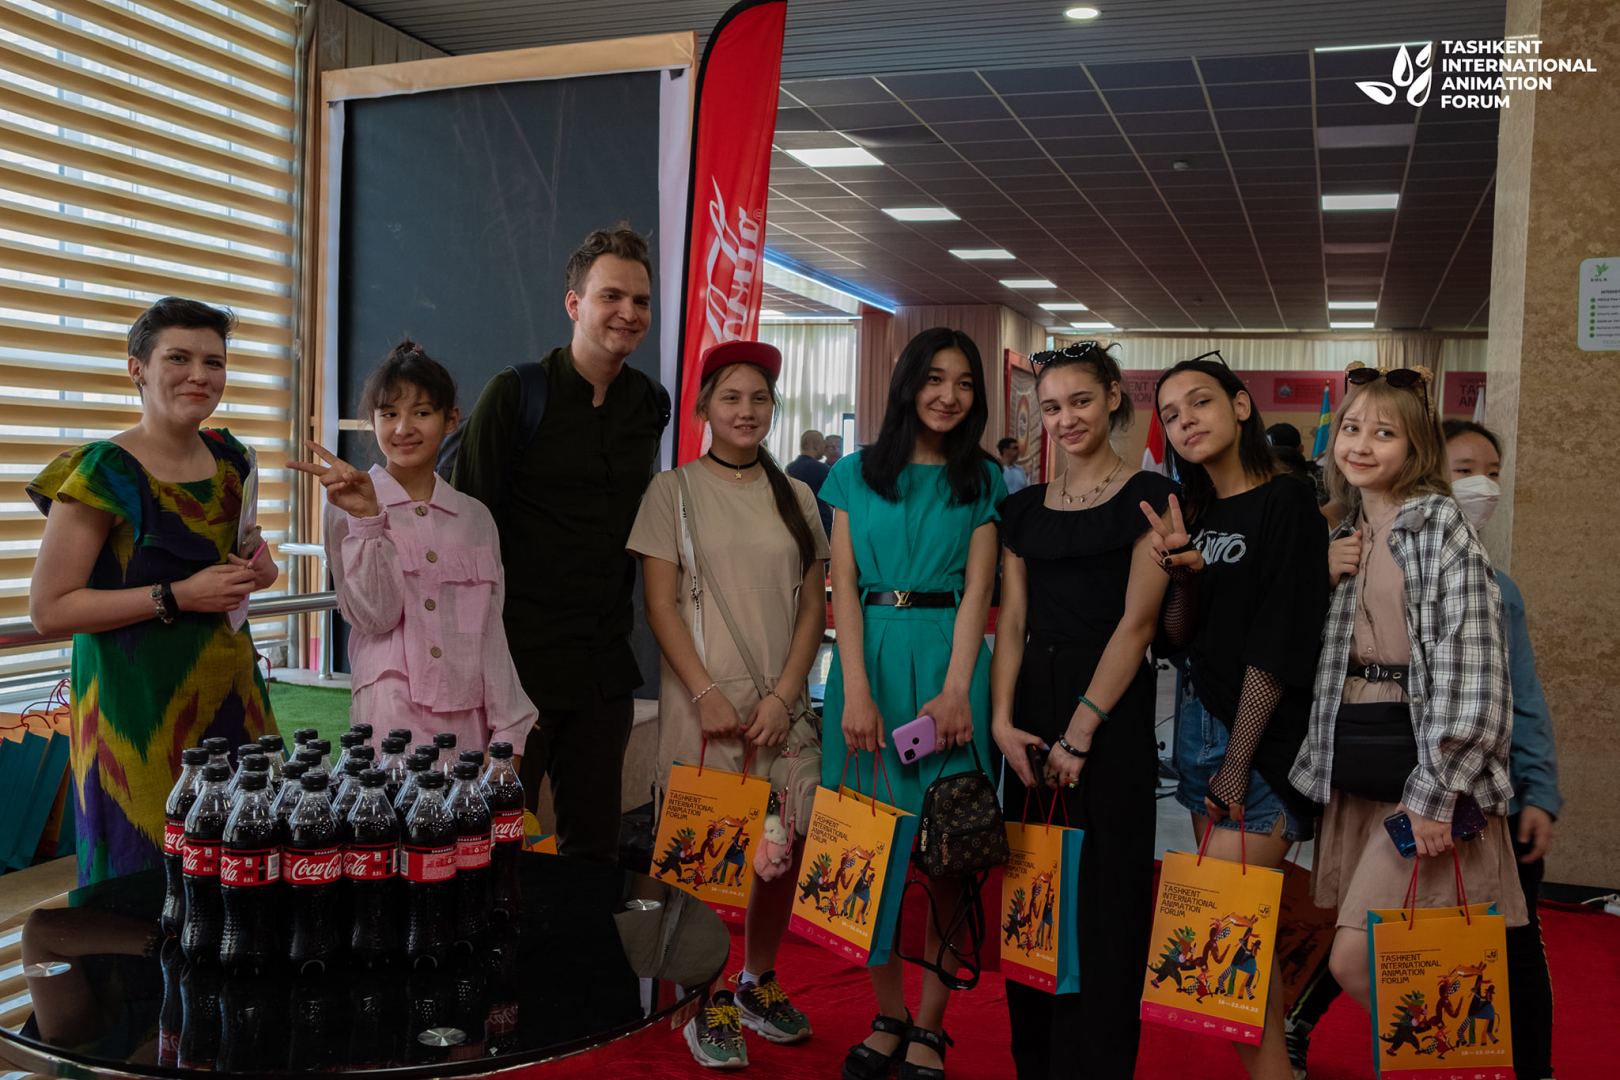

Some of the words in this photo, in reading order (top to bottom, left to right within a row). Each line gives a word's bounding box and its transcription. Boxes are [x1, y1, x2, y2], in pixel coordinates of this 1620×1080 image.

[670, 791, 702, 804] TASHKENT
[667, 805, 702, 817] ANIMATION
[668, 798, 714, 813] INTERNATIONAL
[1163, 884, 1201, 898] TASHKENT
[1161, 899, 1201, 913] ANIMATION
[1162, 892, 1218, 909] INTERNATIONAL
[1159, 906, 1186, 918] FORUM
[1380, 953, 1421, 962] TASHKENT
[1380, 960, 1442, 970] INTERNATIONAL
[1381, 968, 1425, 977] ANIMATION
[1381, 976, 1410, 984] FORUM
